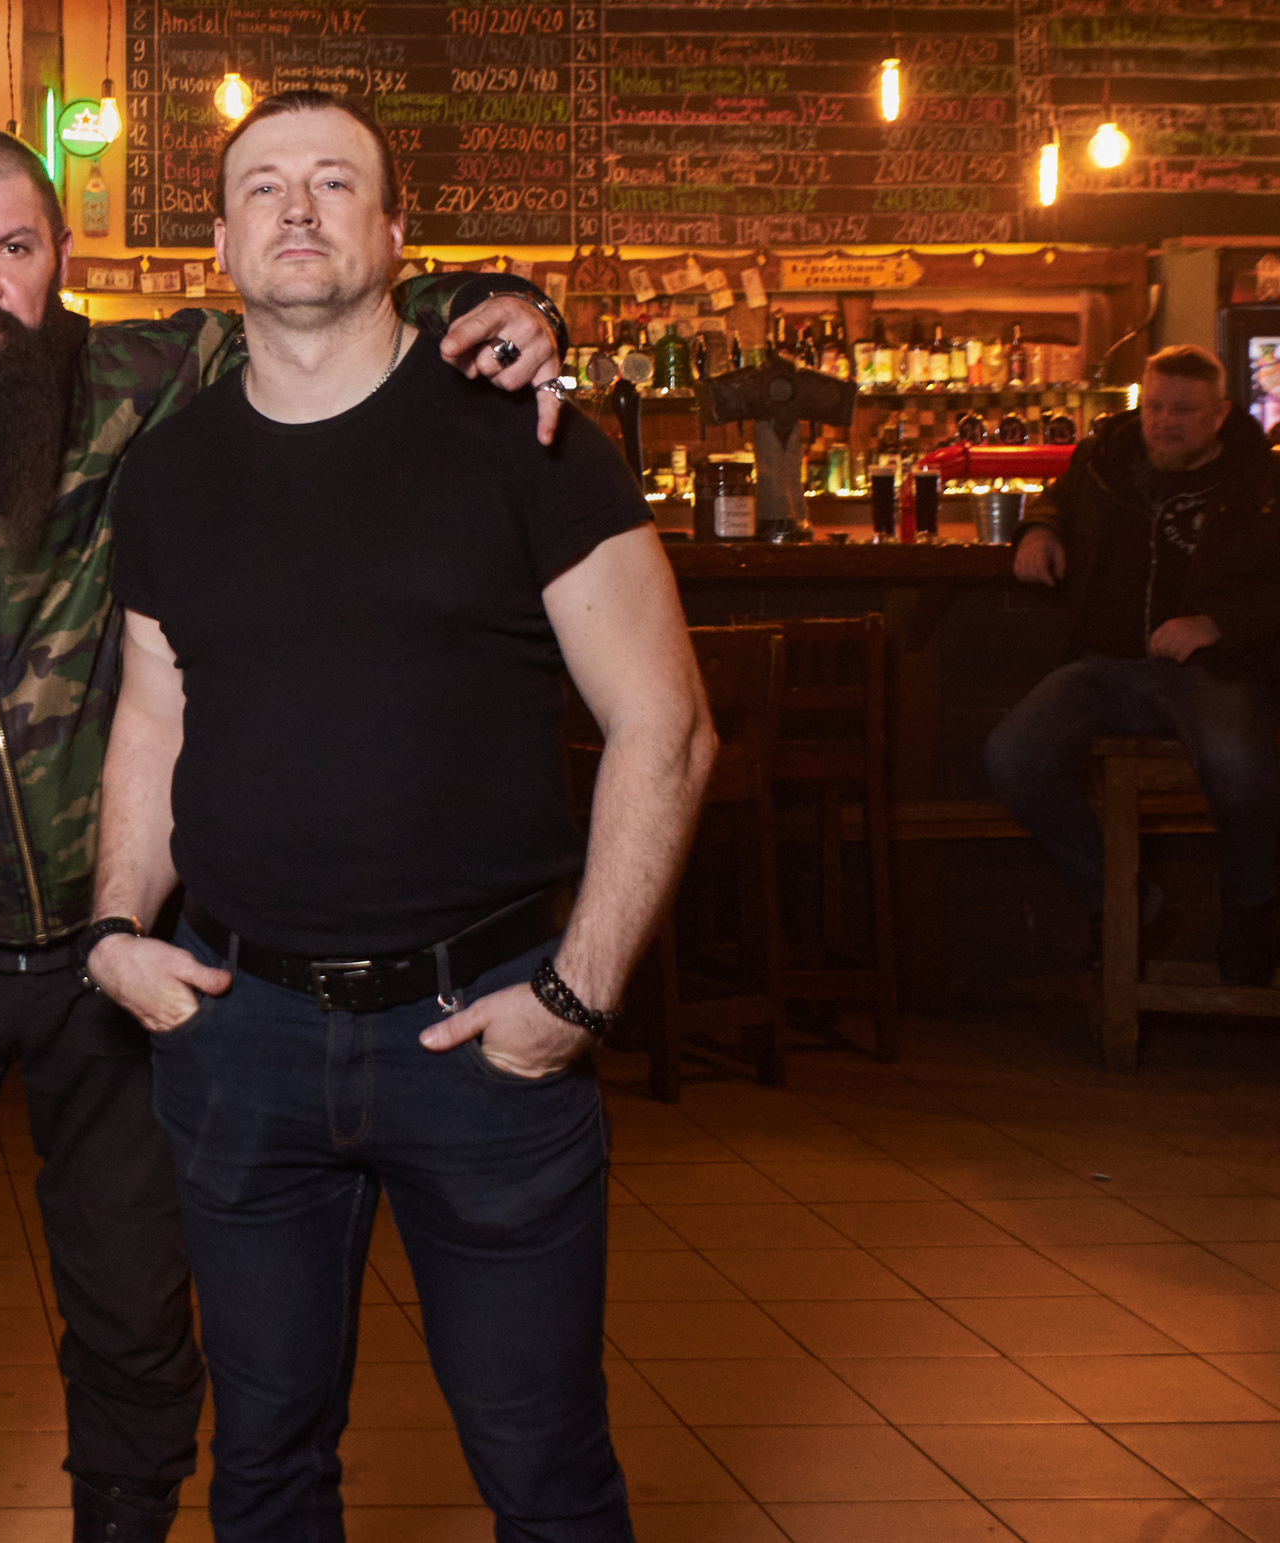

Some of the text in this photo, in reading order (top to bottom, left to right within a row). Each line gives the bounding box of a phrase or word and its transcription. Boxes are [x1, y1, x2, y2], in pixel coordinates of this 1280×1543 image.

[133, 9, 147, 31] 8
[161, 8, 221, 34] Amstel
[446, 4, 564, 37] 170/220/420
[577, 9, 596, 30] 23
[134, 39, 146, 62] 9
[577, 38, 597, 60] 24
[131, 69, 149, 89] 10
[577, 68, 597, 92] 25
[129, 96, 149, 118] 11
[577, 98, 599, 119] 26
[130, 123, 149, 147] 12
[458, 123, 566, 154] 300/350/680
[578, 127, 599, 148] 27
[128, 155, 149, 177] 13
[164, 153, 216, 188] Belgia
[576, 158, 597, 180] 28
[131, 186, 146, 205] 14
[162, 184, 216, 213] Black
[435, 184, 568, 213] 270/320/620
[578, 187, 599, 208] 29
[131, 213, 151, 236] 15
[160, 215, 215, 240] Krusov
[578, 217, 599, 237] 30
